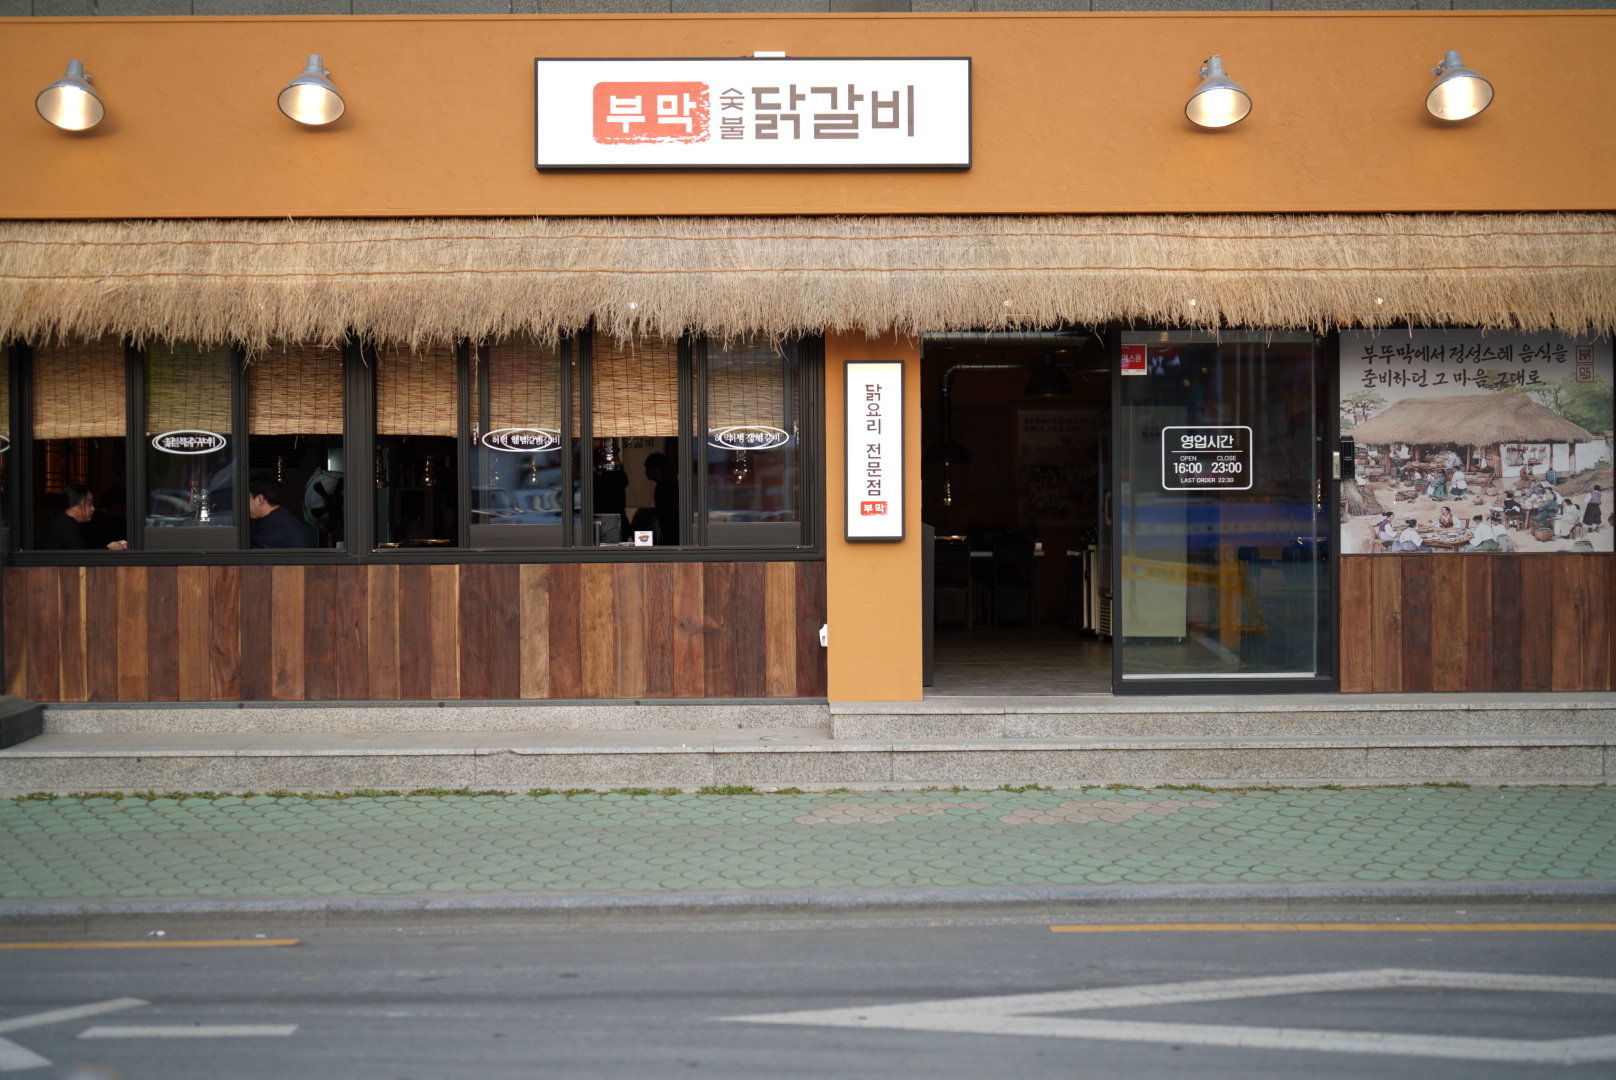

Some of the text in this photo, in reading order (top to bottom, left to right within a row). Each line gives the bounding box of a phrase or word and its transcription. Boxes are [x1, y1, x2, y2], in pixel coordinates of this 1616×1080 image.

[605, 84, 915, 140] 부막 숯불 닭갈비
[1360, 343, 1569, 364] 부뚜막에서 정성스레 음식을
[1361, 369, 1547, 388] 준비하던 그 마음 그대로.
[865, 383, 882, 496] 닭요리 전문점
[1180, 434, 1235, 449] 영업시간
[1173, 462, 1242, 474] 16:00 23:00
[862, 502, 886, 514] 부막
